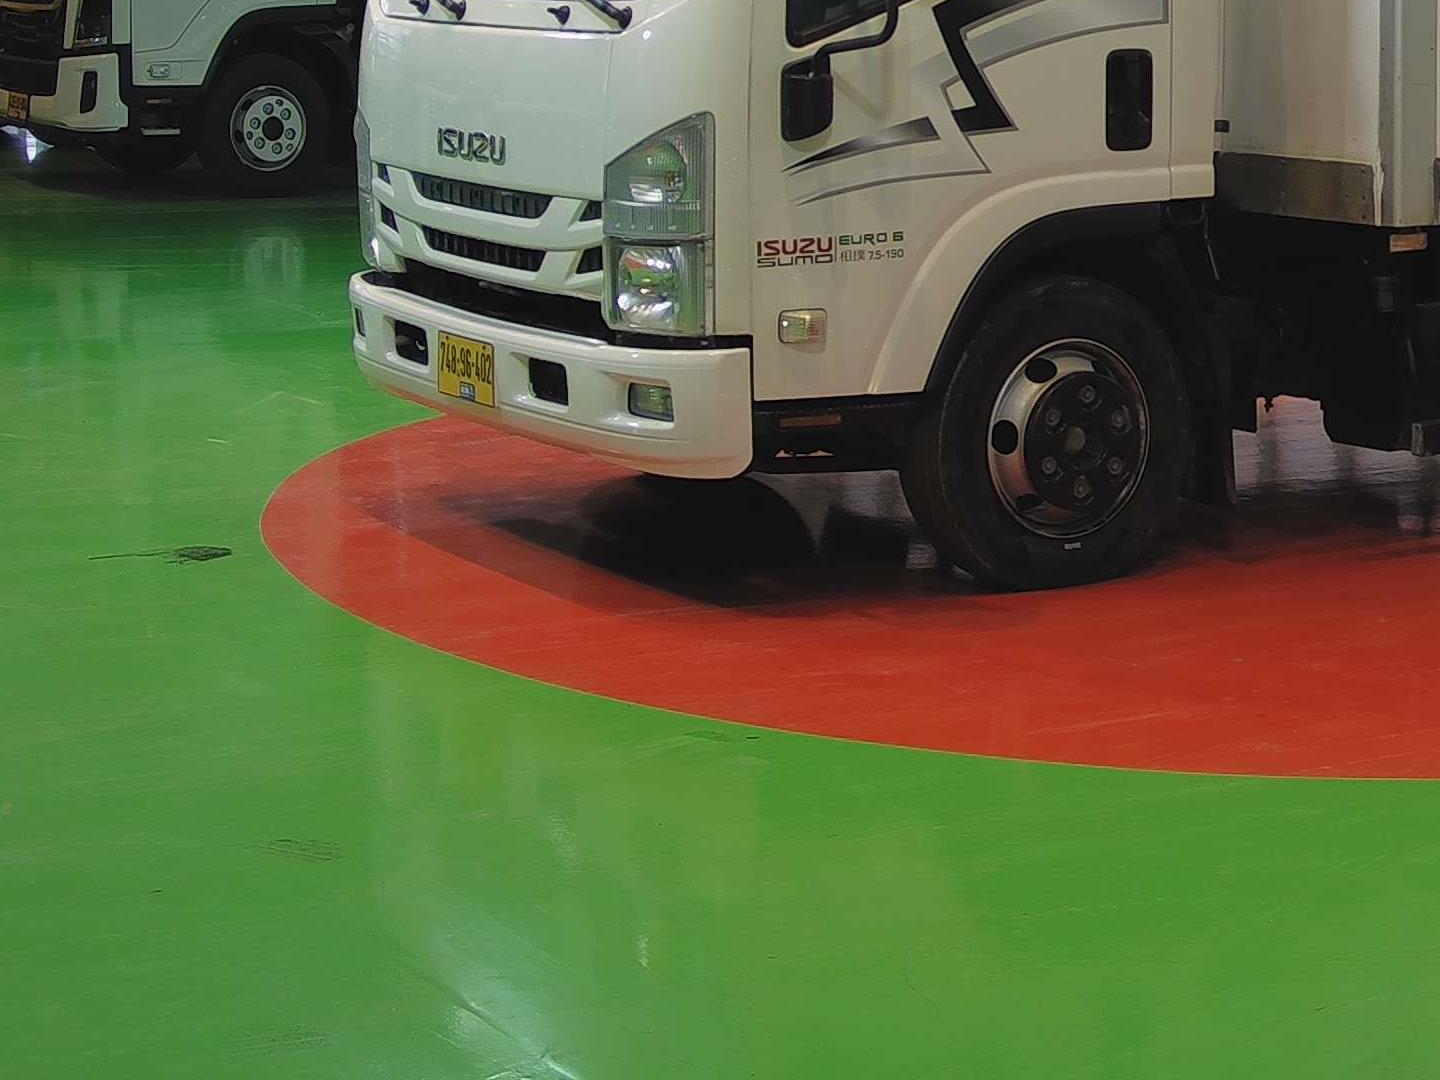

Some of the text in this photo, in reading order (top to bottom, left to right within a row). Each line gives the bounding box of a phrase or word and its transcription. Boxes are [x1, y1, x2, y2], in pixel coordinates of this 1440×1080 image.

[437, 125, 506, 167] ISUZU
[757, 236, 833, 257] ISUZU
[838, 231, 905, 246] EURO 6
[756, 253, 833, 268] SUMO
